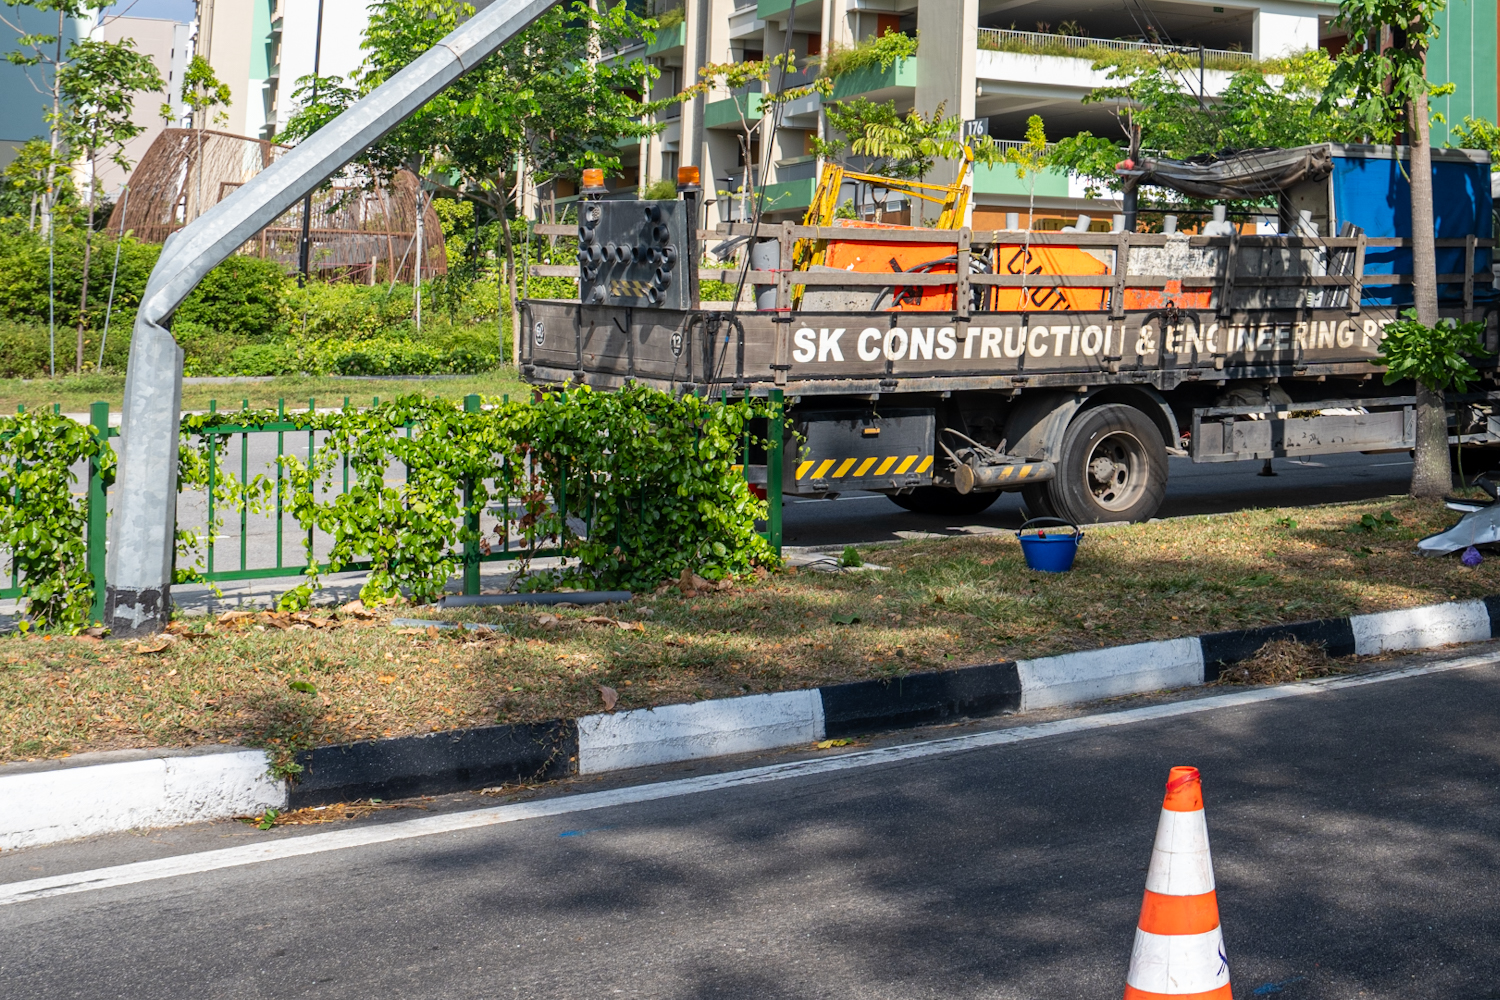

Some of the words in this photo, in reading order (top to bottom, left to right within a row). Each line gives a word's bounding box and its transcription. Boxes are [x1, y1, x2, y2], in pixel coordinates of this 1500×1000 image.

[967, 120, 984, 136] 176
[672, 334, 682, 348] 12
[792, 327, 846, 362] SK
[1135, 324, 1157, 356] &
[1166, 317, 1355, 354] ENGINEERING
